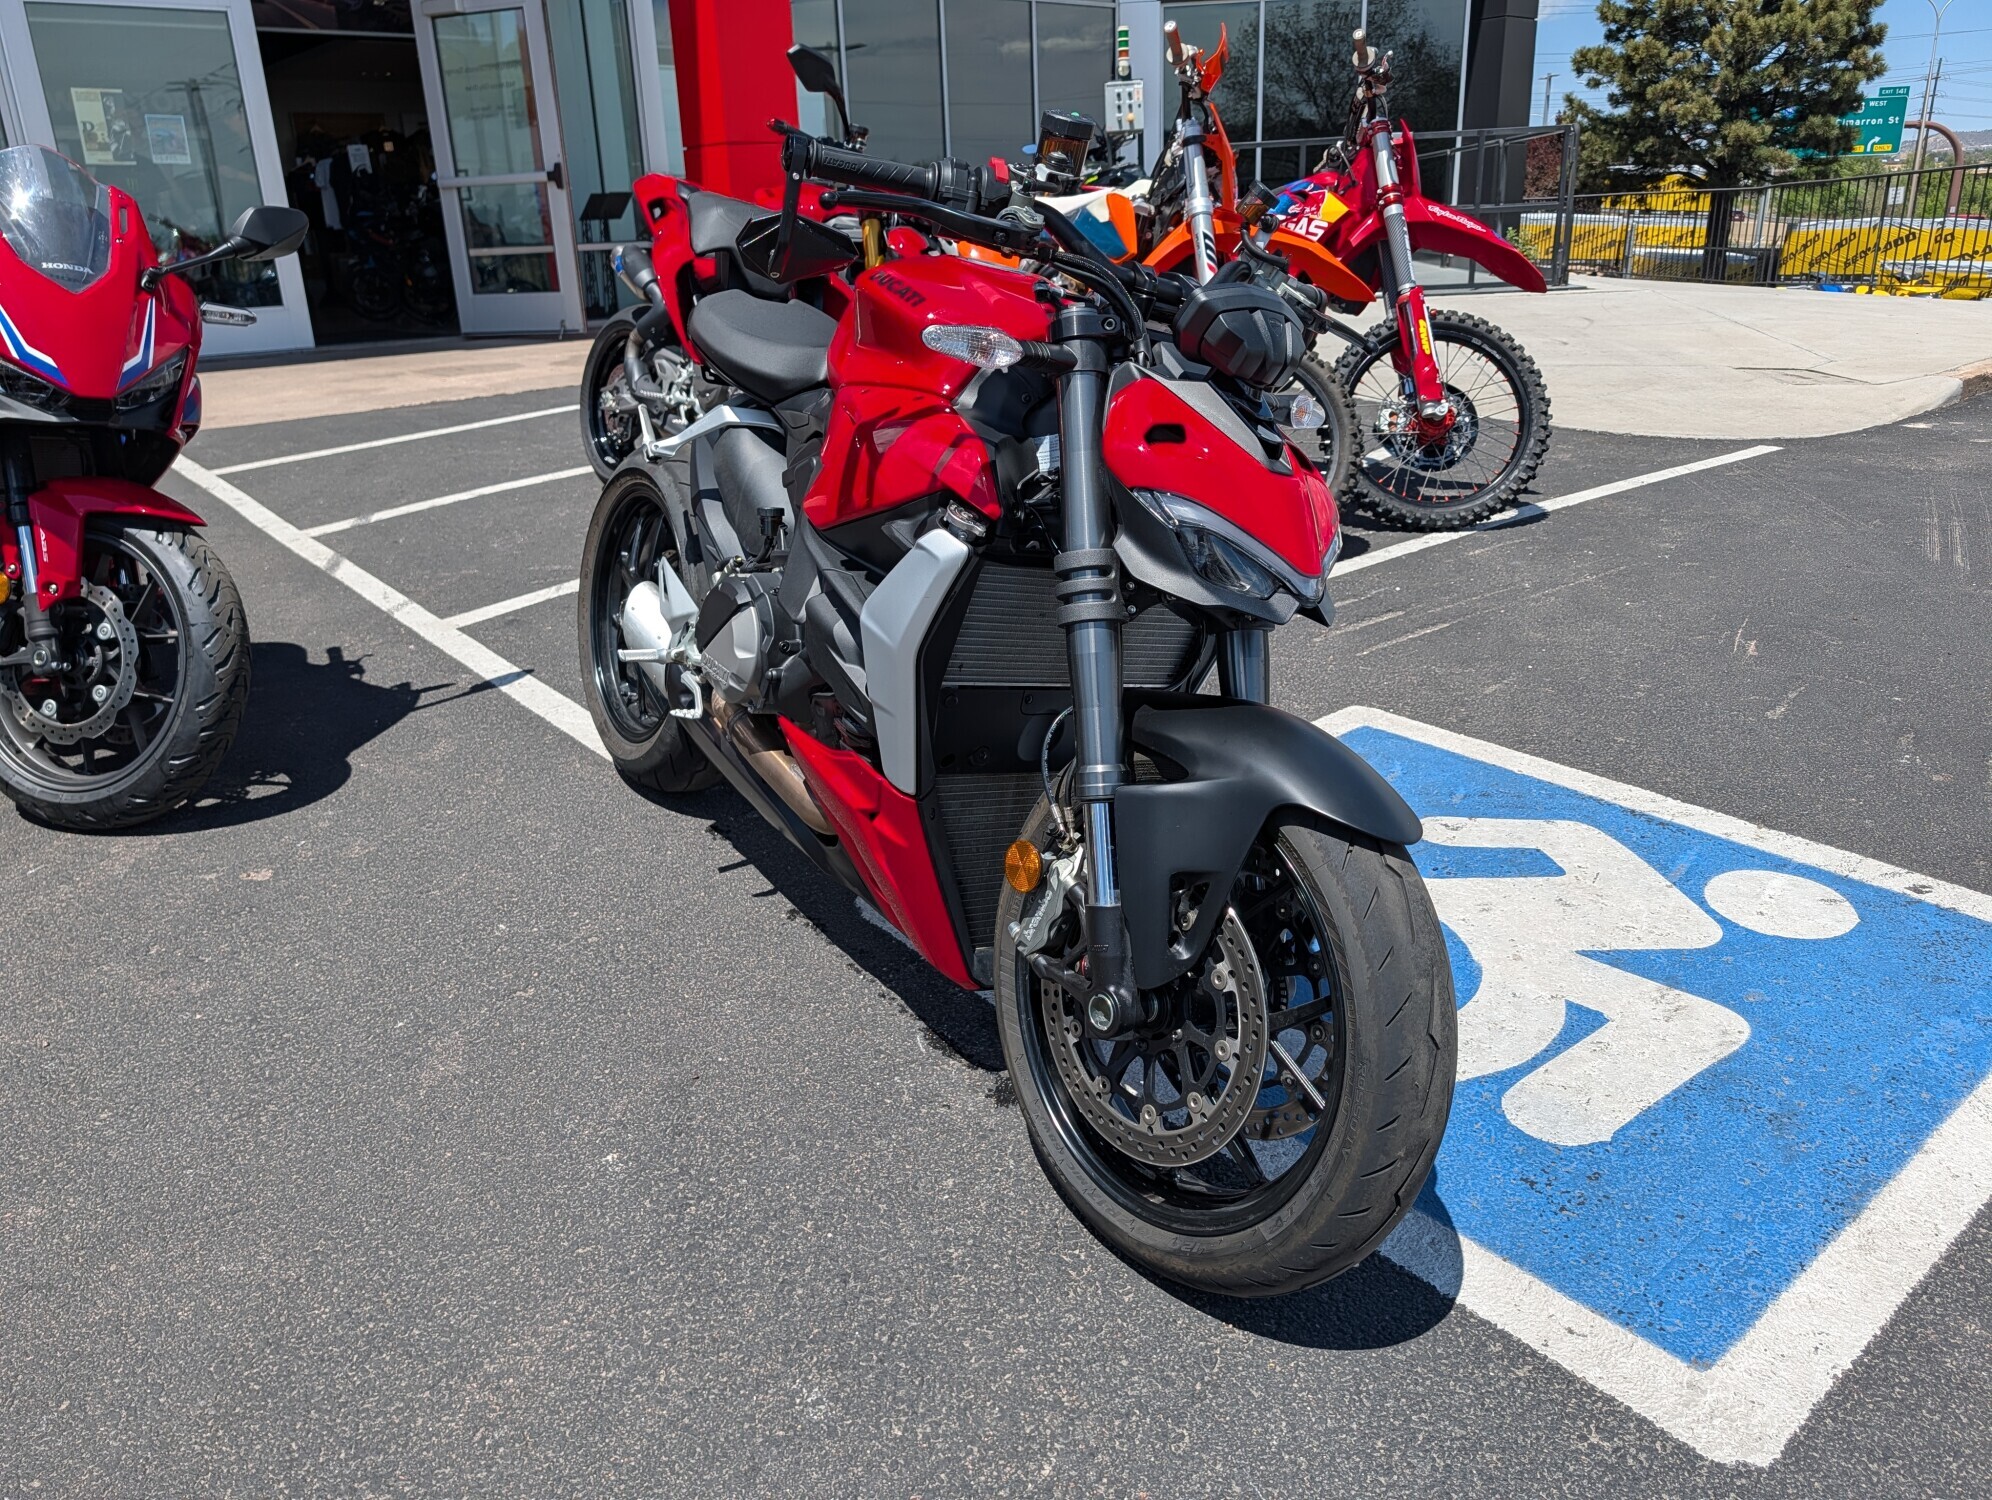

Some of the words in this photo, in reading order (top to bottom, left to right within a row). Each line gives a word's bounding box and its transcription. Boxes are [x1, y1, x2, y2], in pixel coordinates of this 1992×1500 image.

[1836, 117, 1883, 126] Cimarron
[1887, 116, 1900, 125] St
[823, 156, 858, 172] DUCATI
[41, 262, 95, 275] HONDA
[870, 269, 926, 308] DUCATI
[39, 527, 49, 563] ABS
[1348, 1059, 1368, 1131] ROSSO
